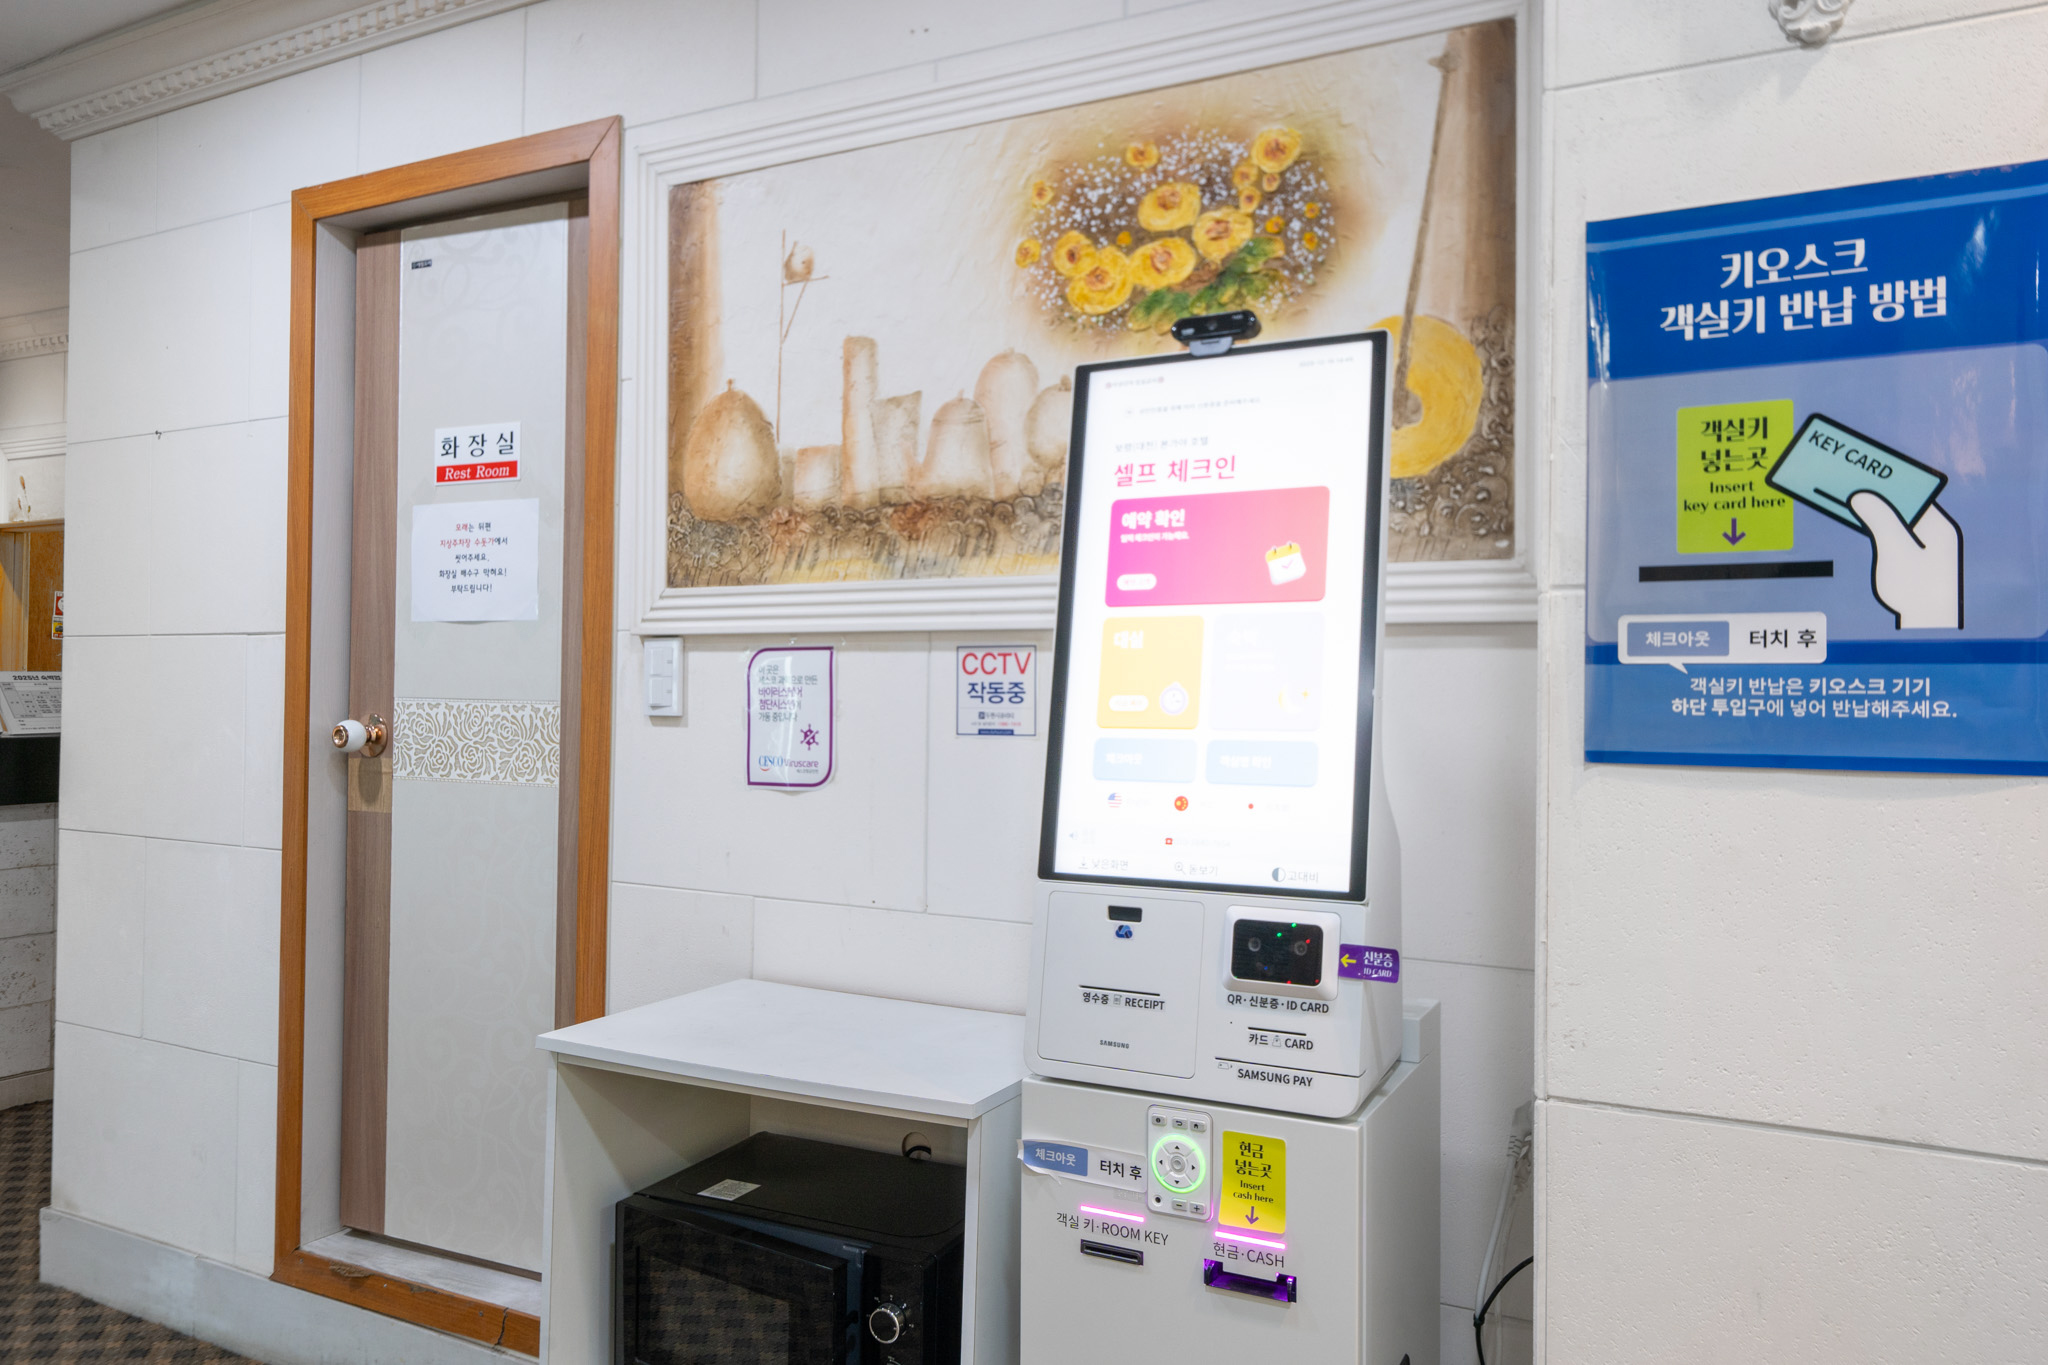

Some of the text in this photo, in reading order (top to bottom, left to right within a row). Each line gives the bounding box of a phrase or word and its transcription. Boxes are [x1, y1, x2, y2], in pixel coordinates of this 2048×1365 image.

[1720, 238, 1869, 289] 키오스크
[1660, 276, 1947, 341] 객실키 반납 방법
[1701, 416, 1768, 443] 객실키
[1701, 446, 1768, 474] 넣는곳
[1808, 430, 1894, 480] KEY CARD
[444, 465, 510, 480] Rest Room
[1114, 455, 1235, 487] 셀프 체크인
[1710, 481, 1755, 494] Insert
[1683, 495, 1786, 513] key card here
[1121, 508, 1186, 530] 예약 확인
[440, 538, 471, 549] 지상주차장
[439, 569, 457, 579] 화장실
[461, 569, 479, 577] 배수구
[451, 584, 492, 593] 부탁드립니다!
[1113, 630, 1144, 649] 대실
[1645, 629, 1818, 649] 체크아웃 터치 후
[962, 652, 1032, 675] CCTV
[967, 681, 1026, 704] 작동중
[1690, 677, 1931, 696] 객실키 반납은 키오스크 기기
[1671, 698, 1957, 719] 하단 투입구에 넣어 반납해주세요.
[1287, 870, 1319, 883] 고대비
[1363, 951, 1393, 968] 신분증
[1363, 967, 1393, 977] ID CARD
[1082, 992, 1165, 1010] 영수증 RECEIPT
[1300, 1001, 1330, 1014] CARD
[1099, 1039, 1130, 1049] SAMSUNG
[1248, 1033, 1314, 1051] 카드 CARD
[1237, 1068, 1313, 1087] SAMSUNG PAY
[1239, 1141, 1264, 1159] 현금
[1035, 1148, 1142, 1180] 체크아웃 터치 후
[1235, 1159, 1272, 1180] 넣는곳
[1240, 1180, 1266, 1192] Insert
[1233, 1191, 1275, 1203] cash here
[1056, 1212, 1080, 1230] 객실
[1144, 1230, 1169, 1247] KEY
